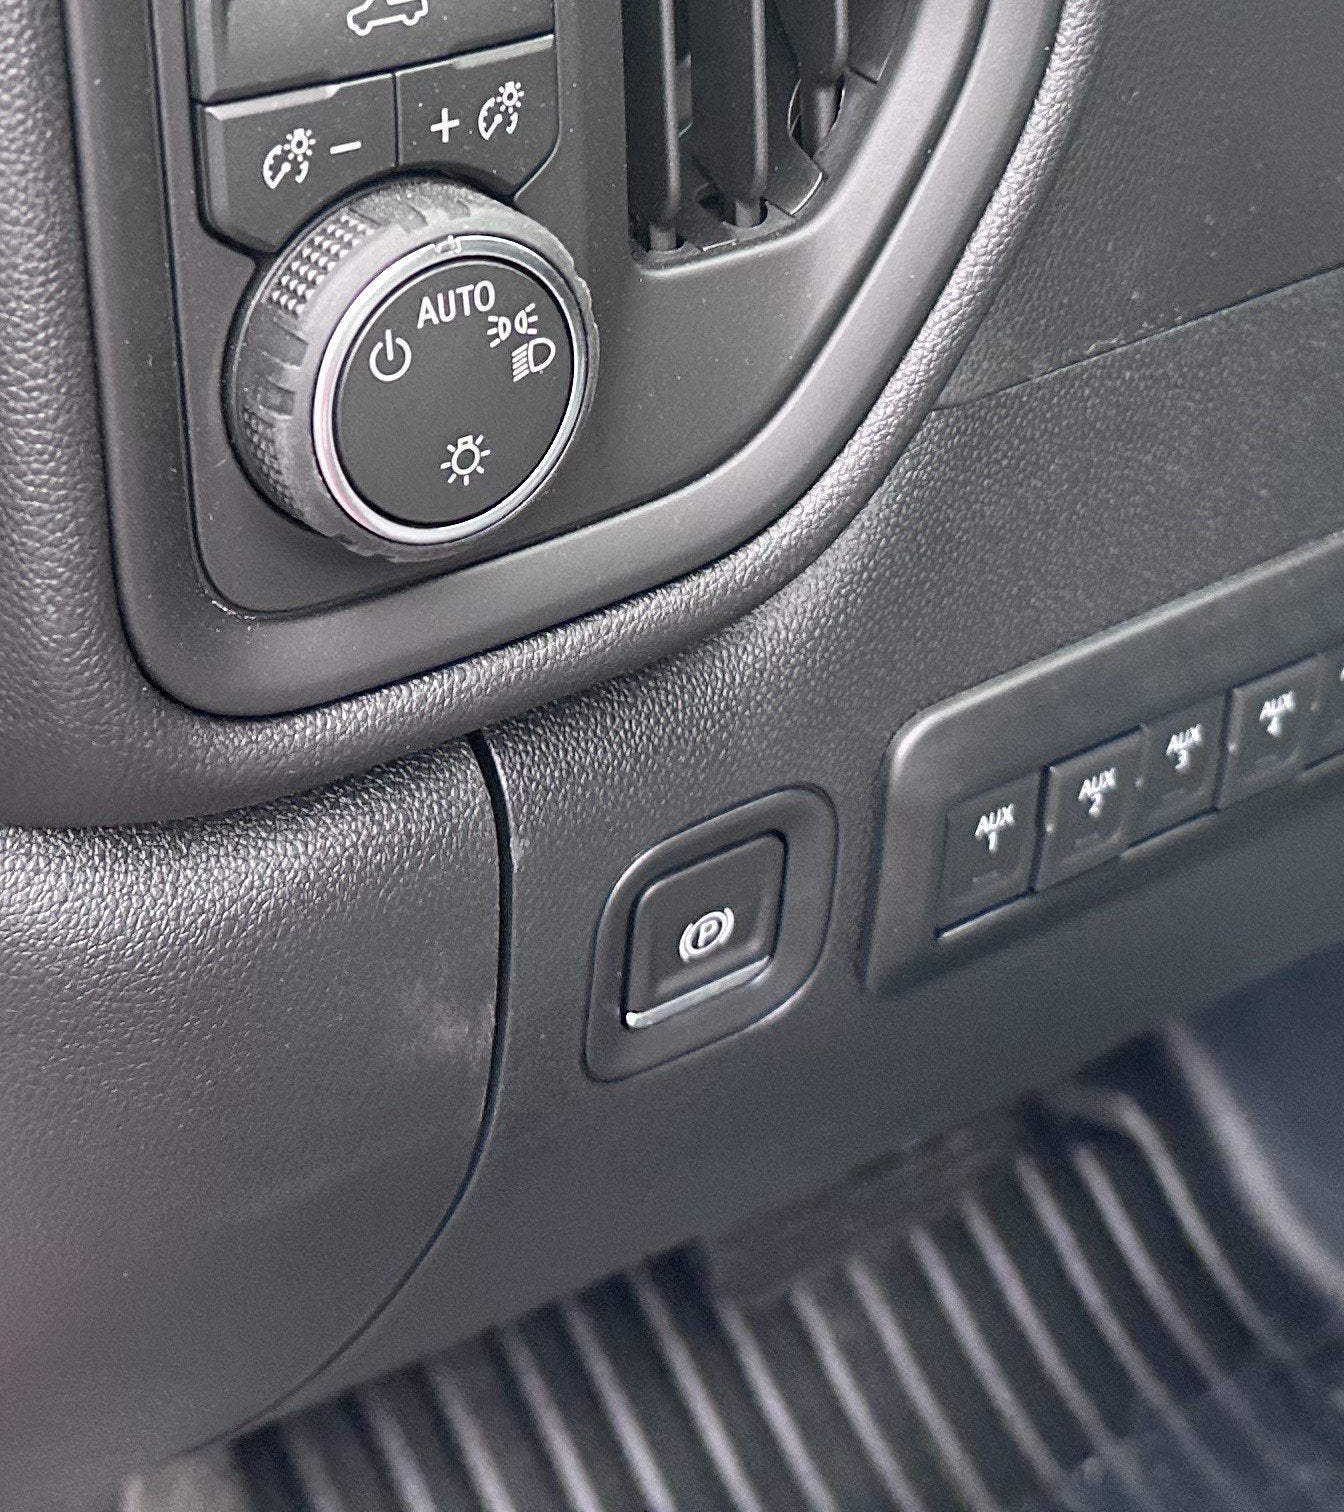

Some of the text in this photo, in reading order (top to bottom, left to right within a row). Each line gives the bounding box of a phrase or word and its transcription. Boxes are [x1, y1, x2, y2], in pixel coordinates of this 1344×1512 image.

[416, 279, 496, 330] AUTO
[1259, 690, 1295, 722] AUX
[1166, 723, 1202, 757] AUX
[1267, 717, 1281, 737] 4
[1174, 750, 1189, 772] 3
[1078, 767, 1117, 802] AUX
[975, 802, 1016, 839] AUX
[1088, 793, 1103, 818] 2
[988, 832, 998, 853] 1
